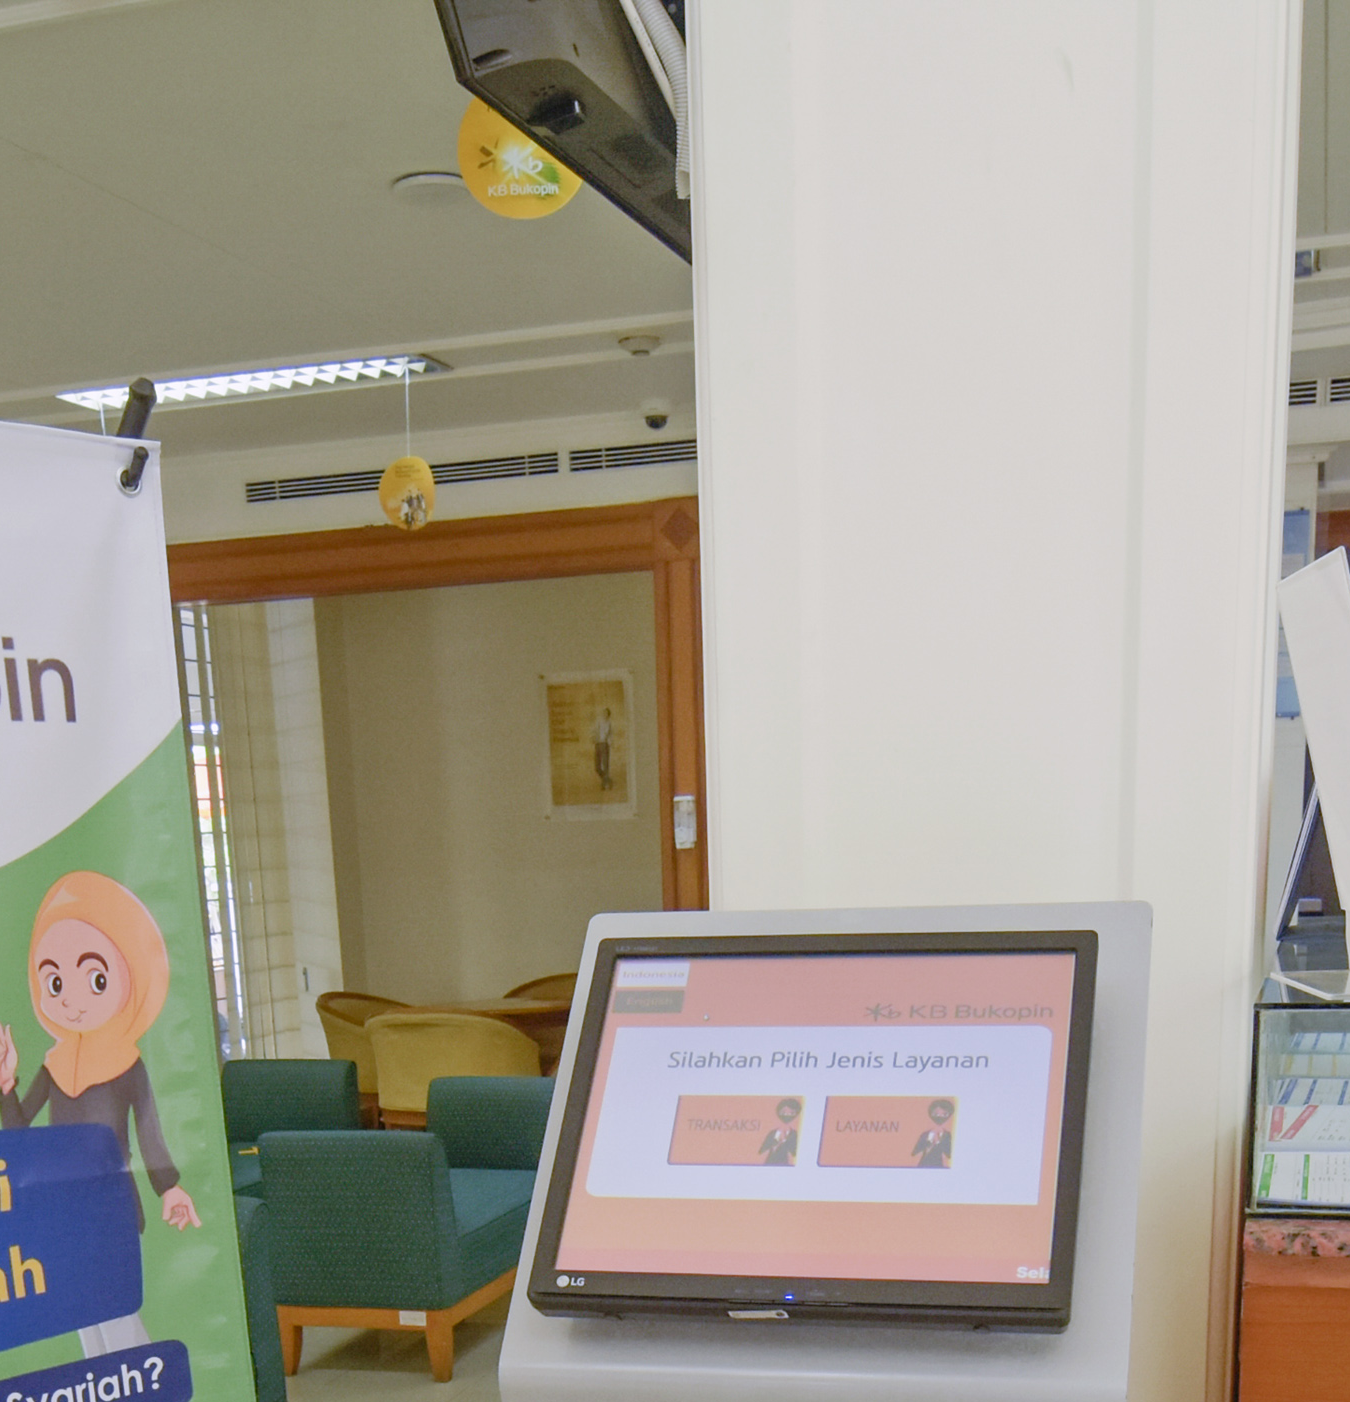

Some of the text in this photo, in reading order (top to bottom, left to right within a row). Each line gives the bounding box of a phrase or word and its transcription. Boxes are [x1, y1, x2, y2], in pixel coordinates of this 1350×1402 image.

[908, 1002, 1054, 1023] KB Bukopin
[667, 1050, 990, 1074] Silahkan Pilih Jenis Layanan
[686, 1118, 762, 1133] TRANSAKSI
[835, 1119, 901, 1134] LAYANAN
[570, 1277, 586, 1287] LG
